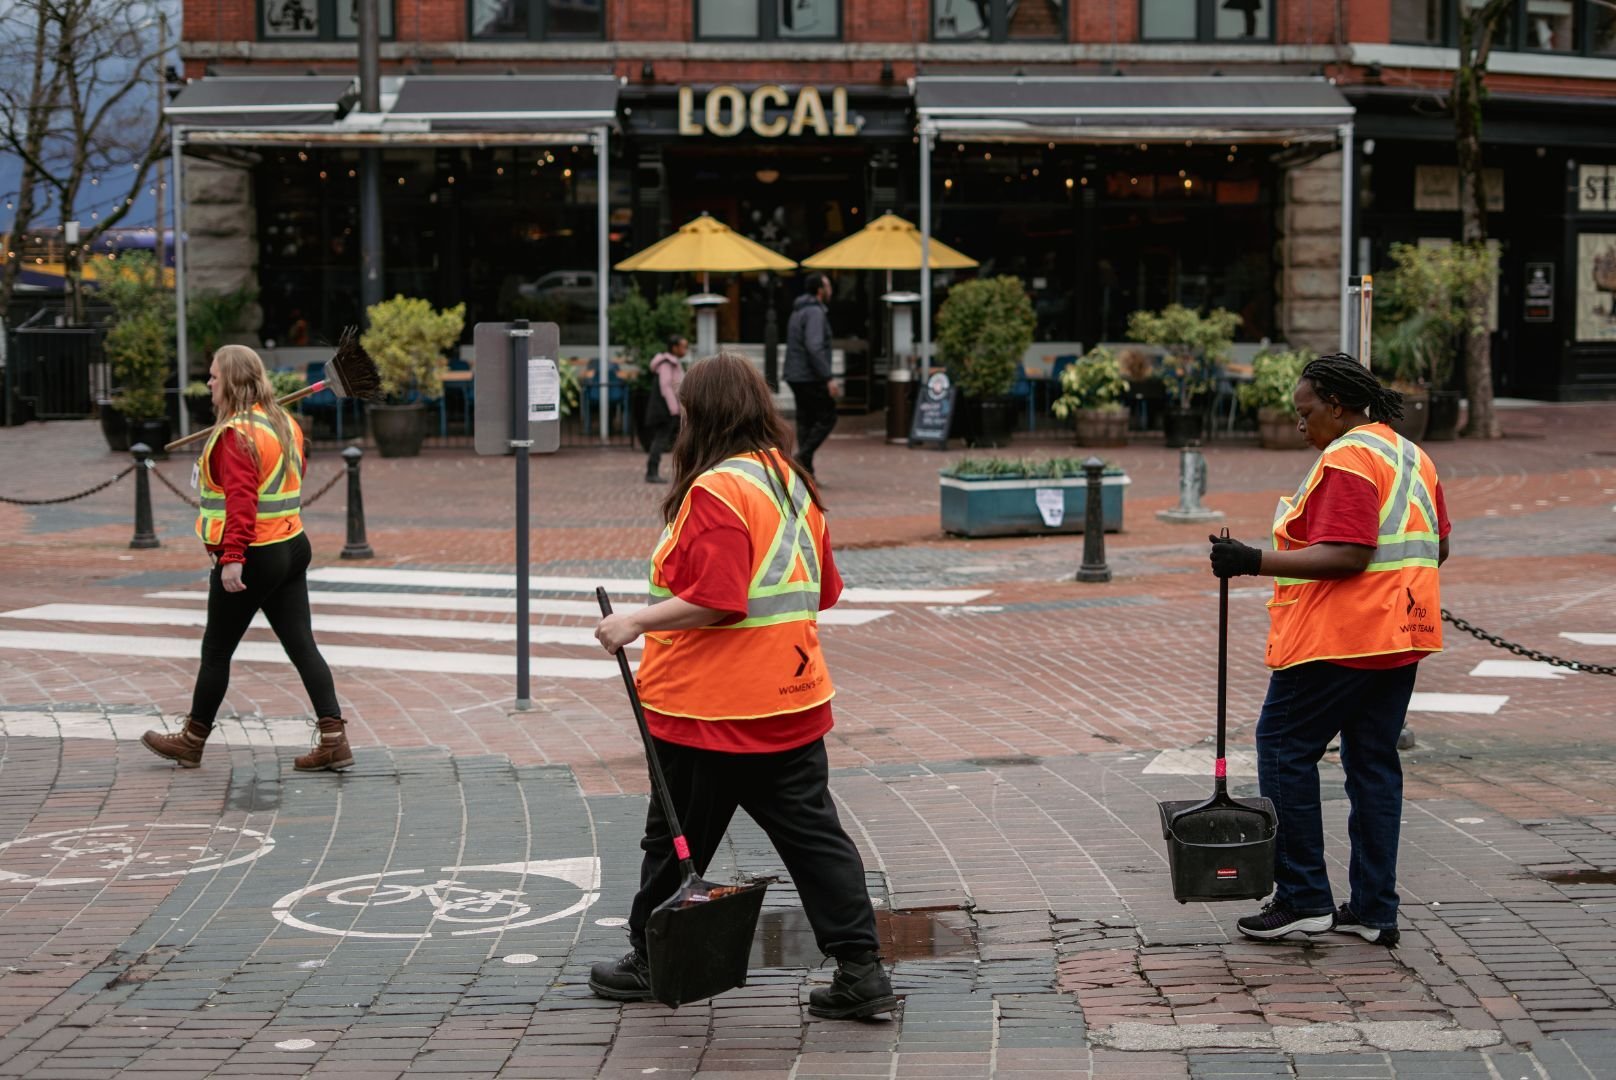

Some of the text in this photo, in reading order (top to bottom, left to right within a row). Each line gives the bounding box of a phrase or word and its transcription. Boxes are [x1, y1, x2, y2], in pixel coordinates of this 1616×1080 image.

[678, 85, 858, 137] LOCAL
[1585, 175, 1616, 201] ST
[1418, 624, 1434, 633] TEAM
